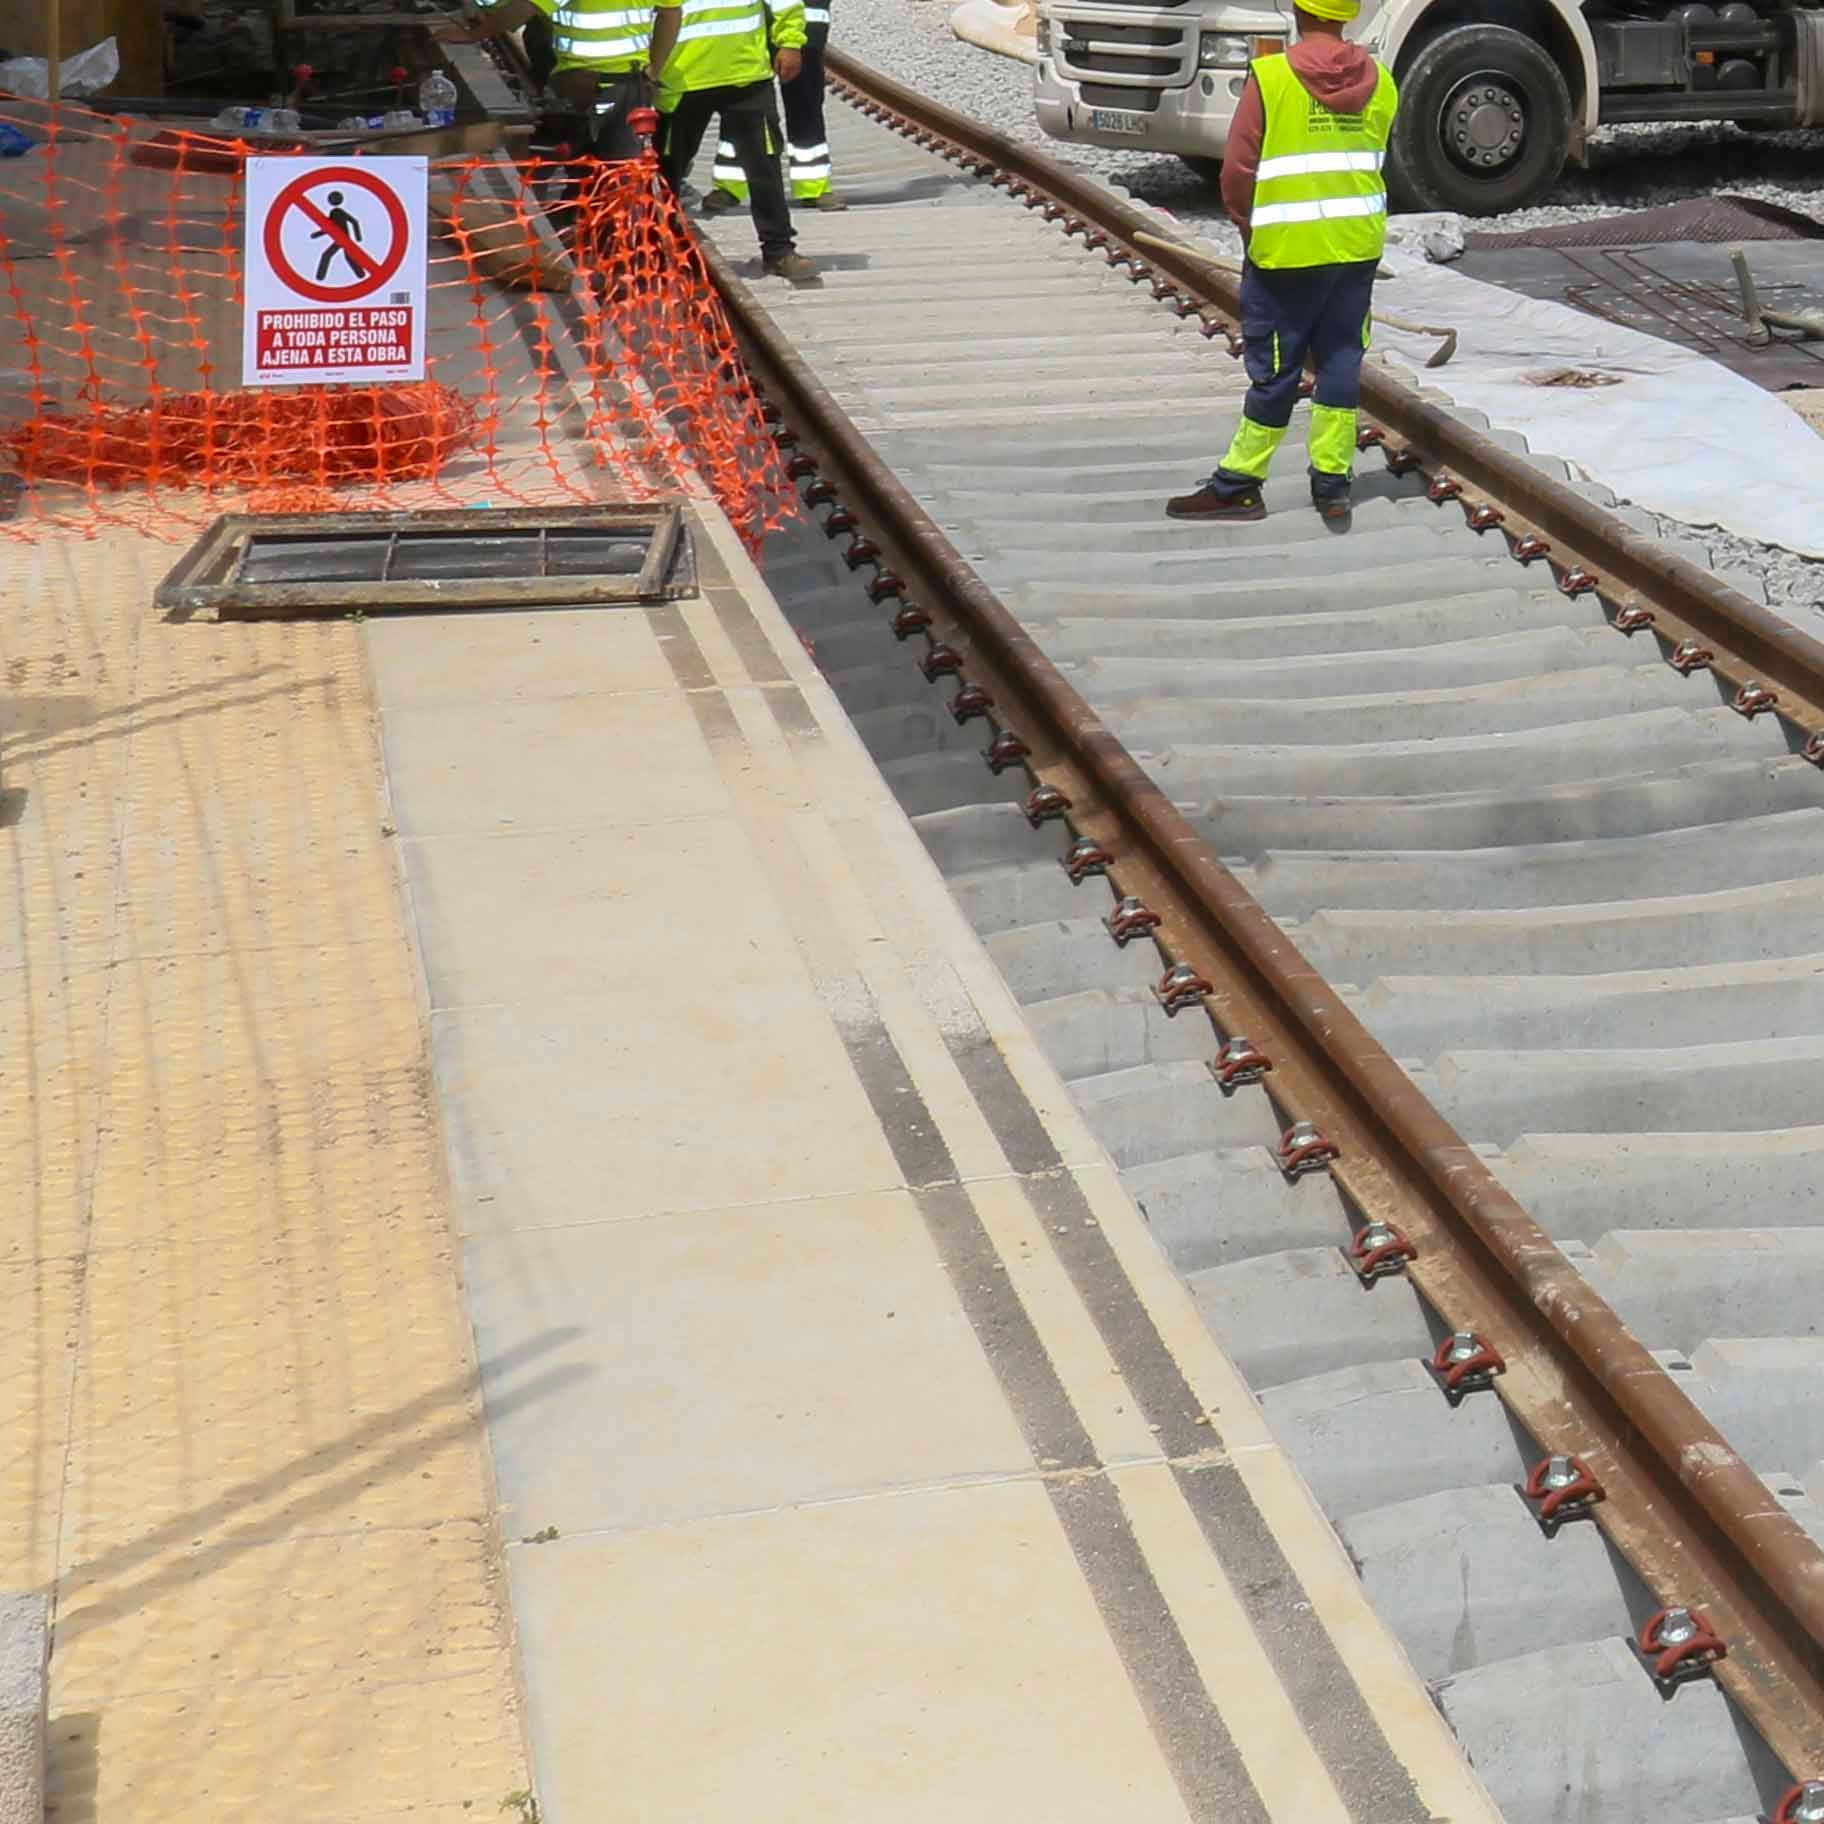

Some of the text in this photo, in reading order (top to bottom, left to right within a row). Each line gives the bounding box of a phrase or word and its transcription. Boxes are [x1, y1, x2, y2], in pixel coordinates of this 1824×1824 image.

[263, 310, 407, 330] PROHIBIDO EL PASO
[272, 329, 397, 347] A TODA PERSONA
[262, 345, 406, 366] AJENA A ESTA OBRA
